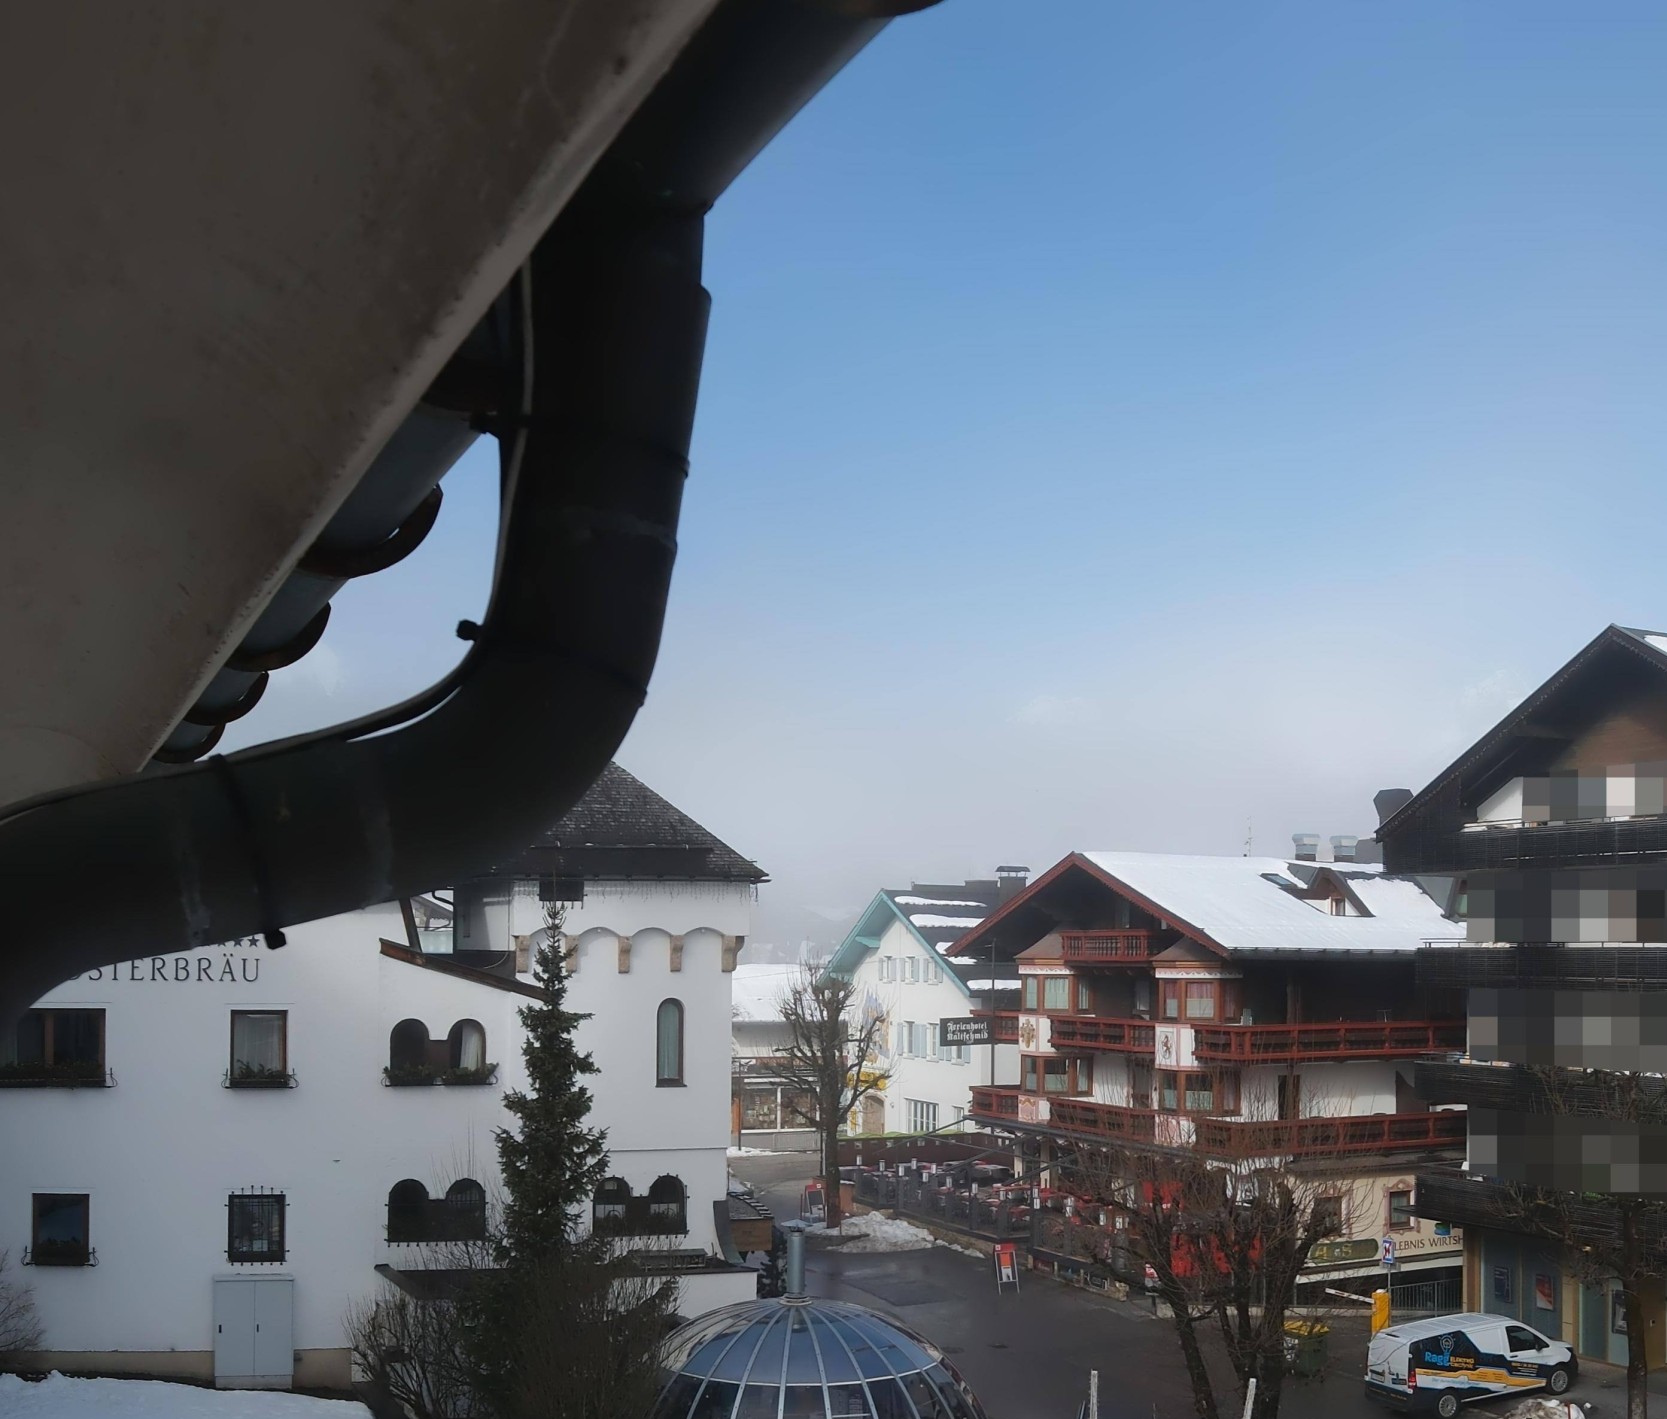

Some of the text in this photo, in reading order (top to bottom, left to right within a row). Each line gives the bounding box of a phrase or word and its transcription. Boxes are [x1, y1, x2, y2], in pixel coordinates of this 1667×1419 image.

[68, 953, 260, 982] STERBRÄU
[1393, 1238, 1425, 1251] LEBNIS
[1425, 1351, 1450, 1367] Ragg
